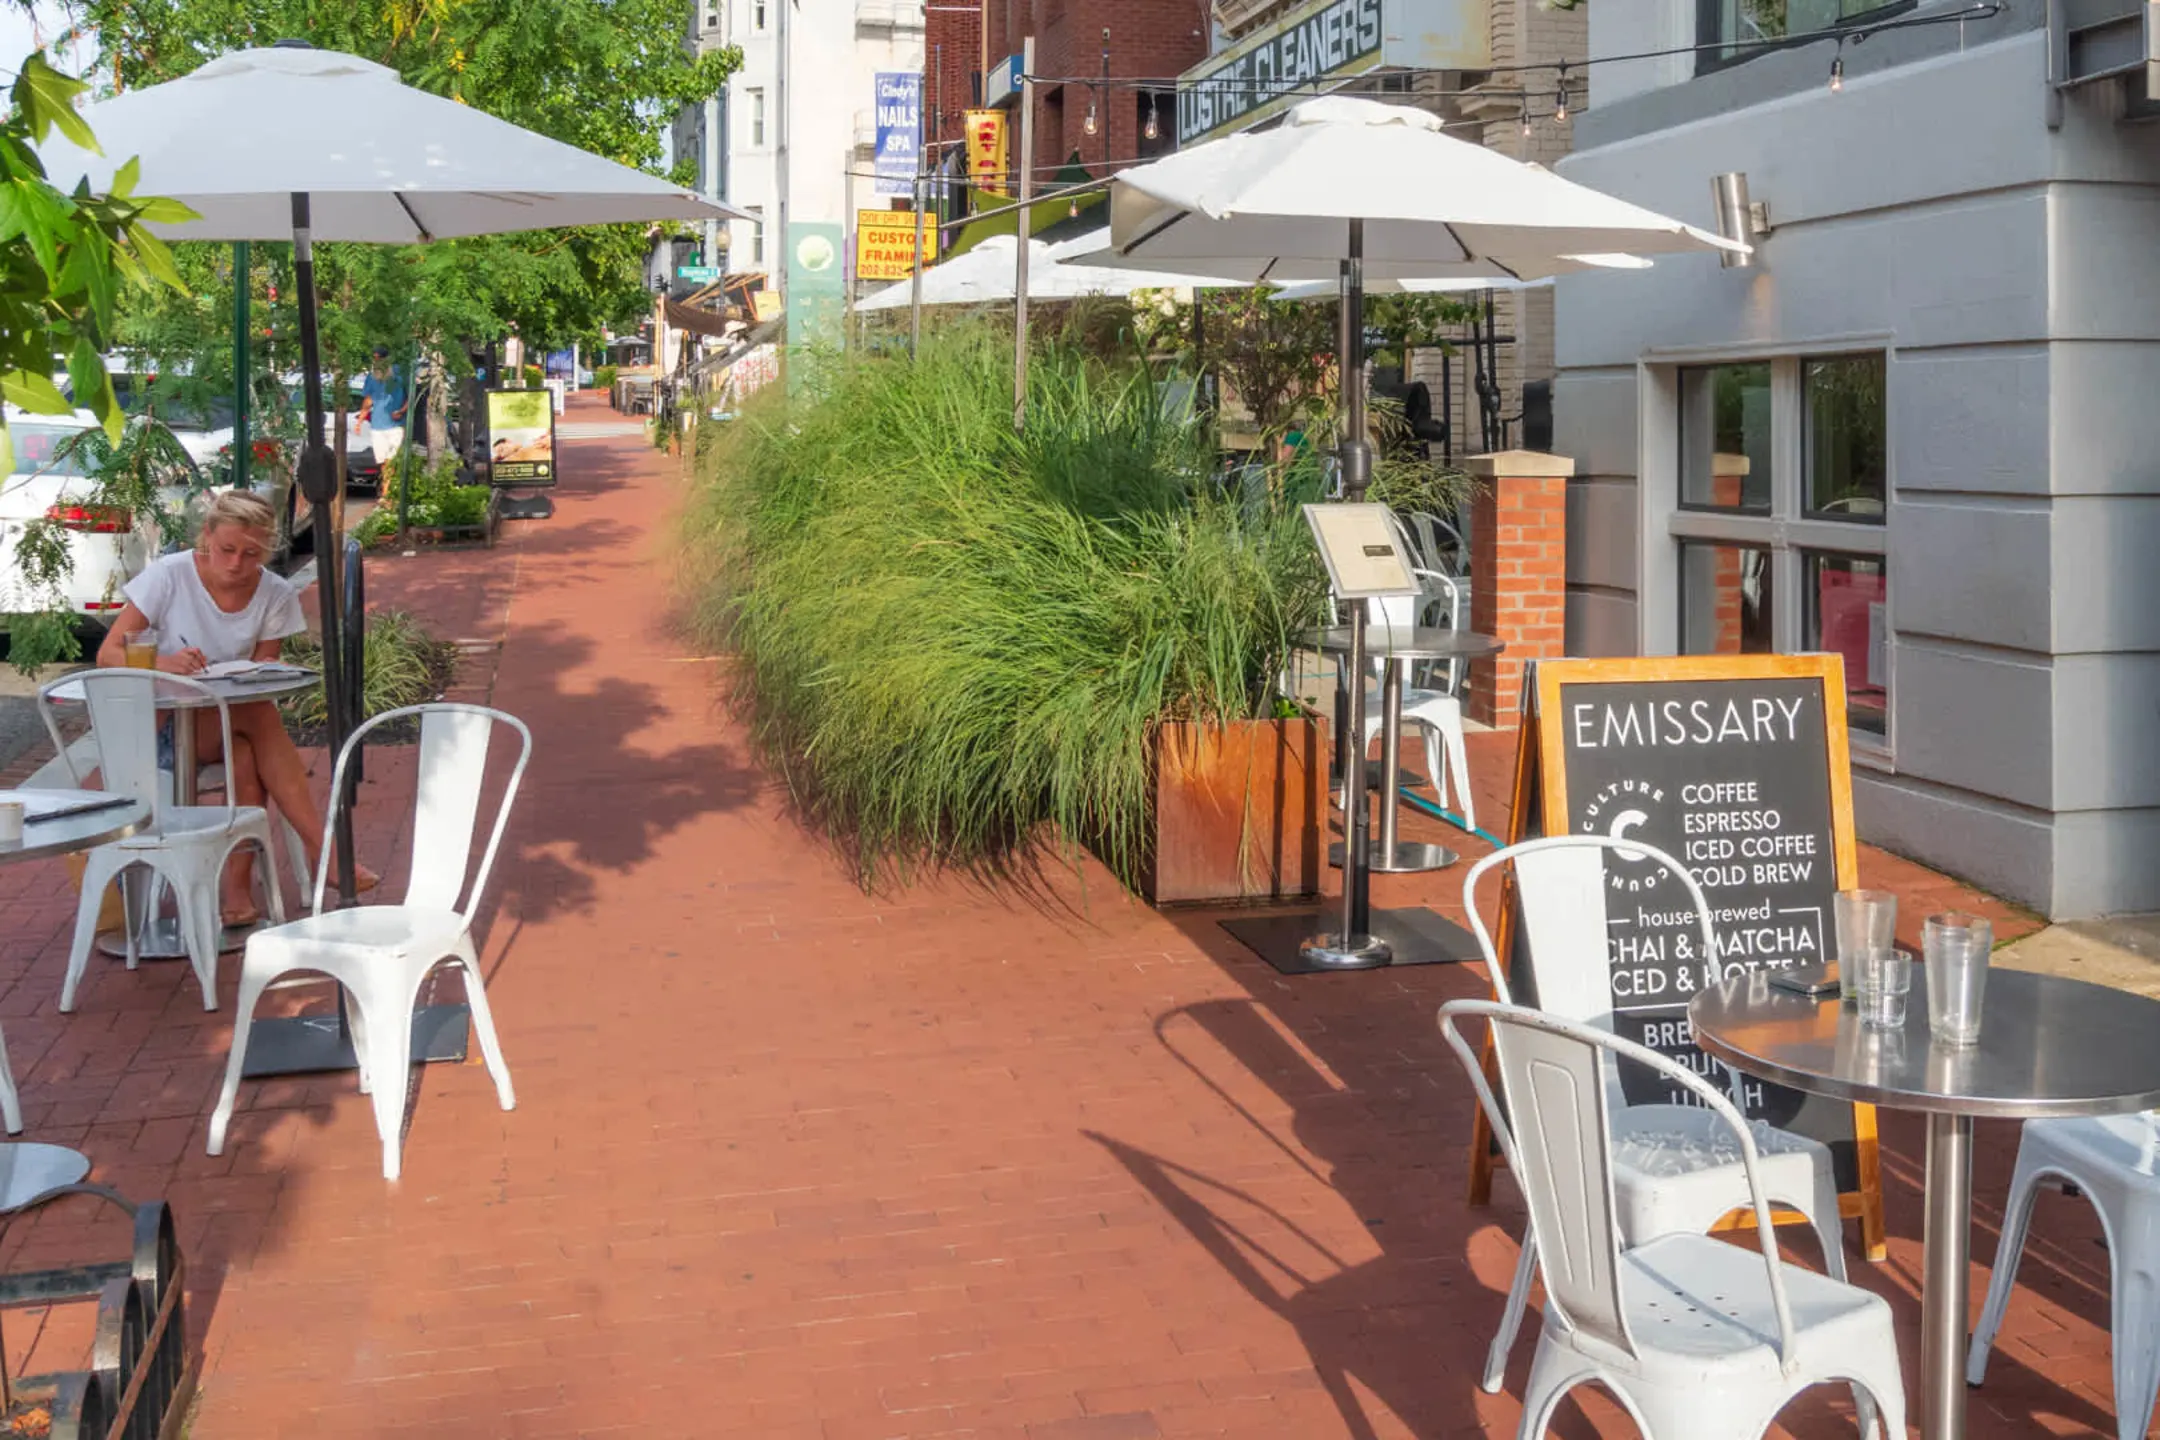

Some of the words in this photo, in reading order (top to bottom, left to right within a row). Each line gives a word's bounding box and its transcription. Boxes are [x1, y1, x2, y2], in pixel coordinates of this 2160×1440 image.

[1180, 57, 1248, 140] LUSTRE
[1254, 0, 1379, 103] CLEANERS
[877, 105, 918, 128] NAILS
[885, 134, 911, 152] SPA
[1574, 698, 1802, 748] EMISSARY
[1583, 779, 1664, 832] CULTURE
[1681, 782, 1758, 804] COFFEE
[1684, 810, 1780, 834] ESPRESSO
[1686, 840, 1734, 861] ICED
[1740, 834, 1816, 857] COFFEE
[1688, 865, 1746, 888] COLD
[1753, 861, 1813, 884] BREW
[1608, 936, 1666, 964] CHAI
[1675, 934, 1694, 959] &
[1703, 927, 1815, 957] MATCHA
[1611, 968, 1668, 997] CED
[1675, 966, 1696, 992] &
